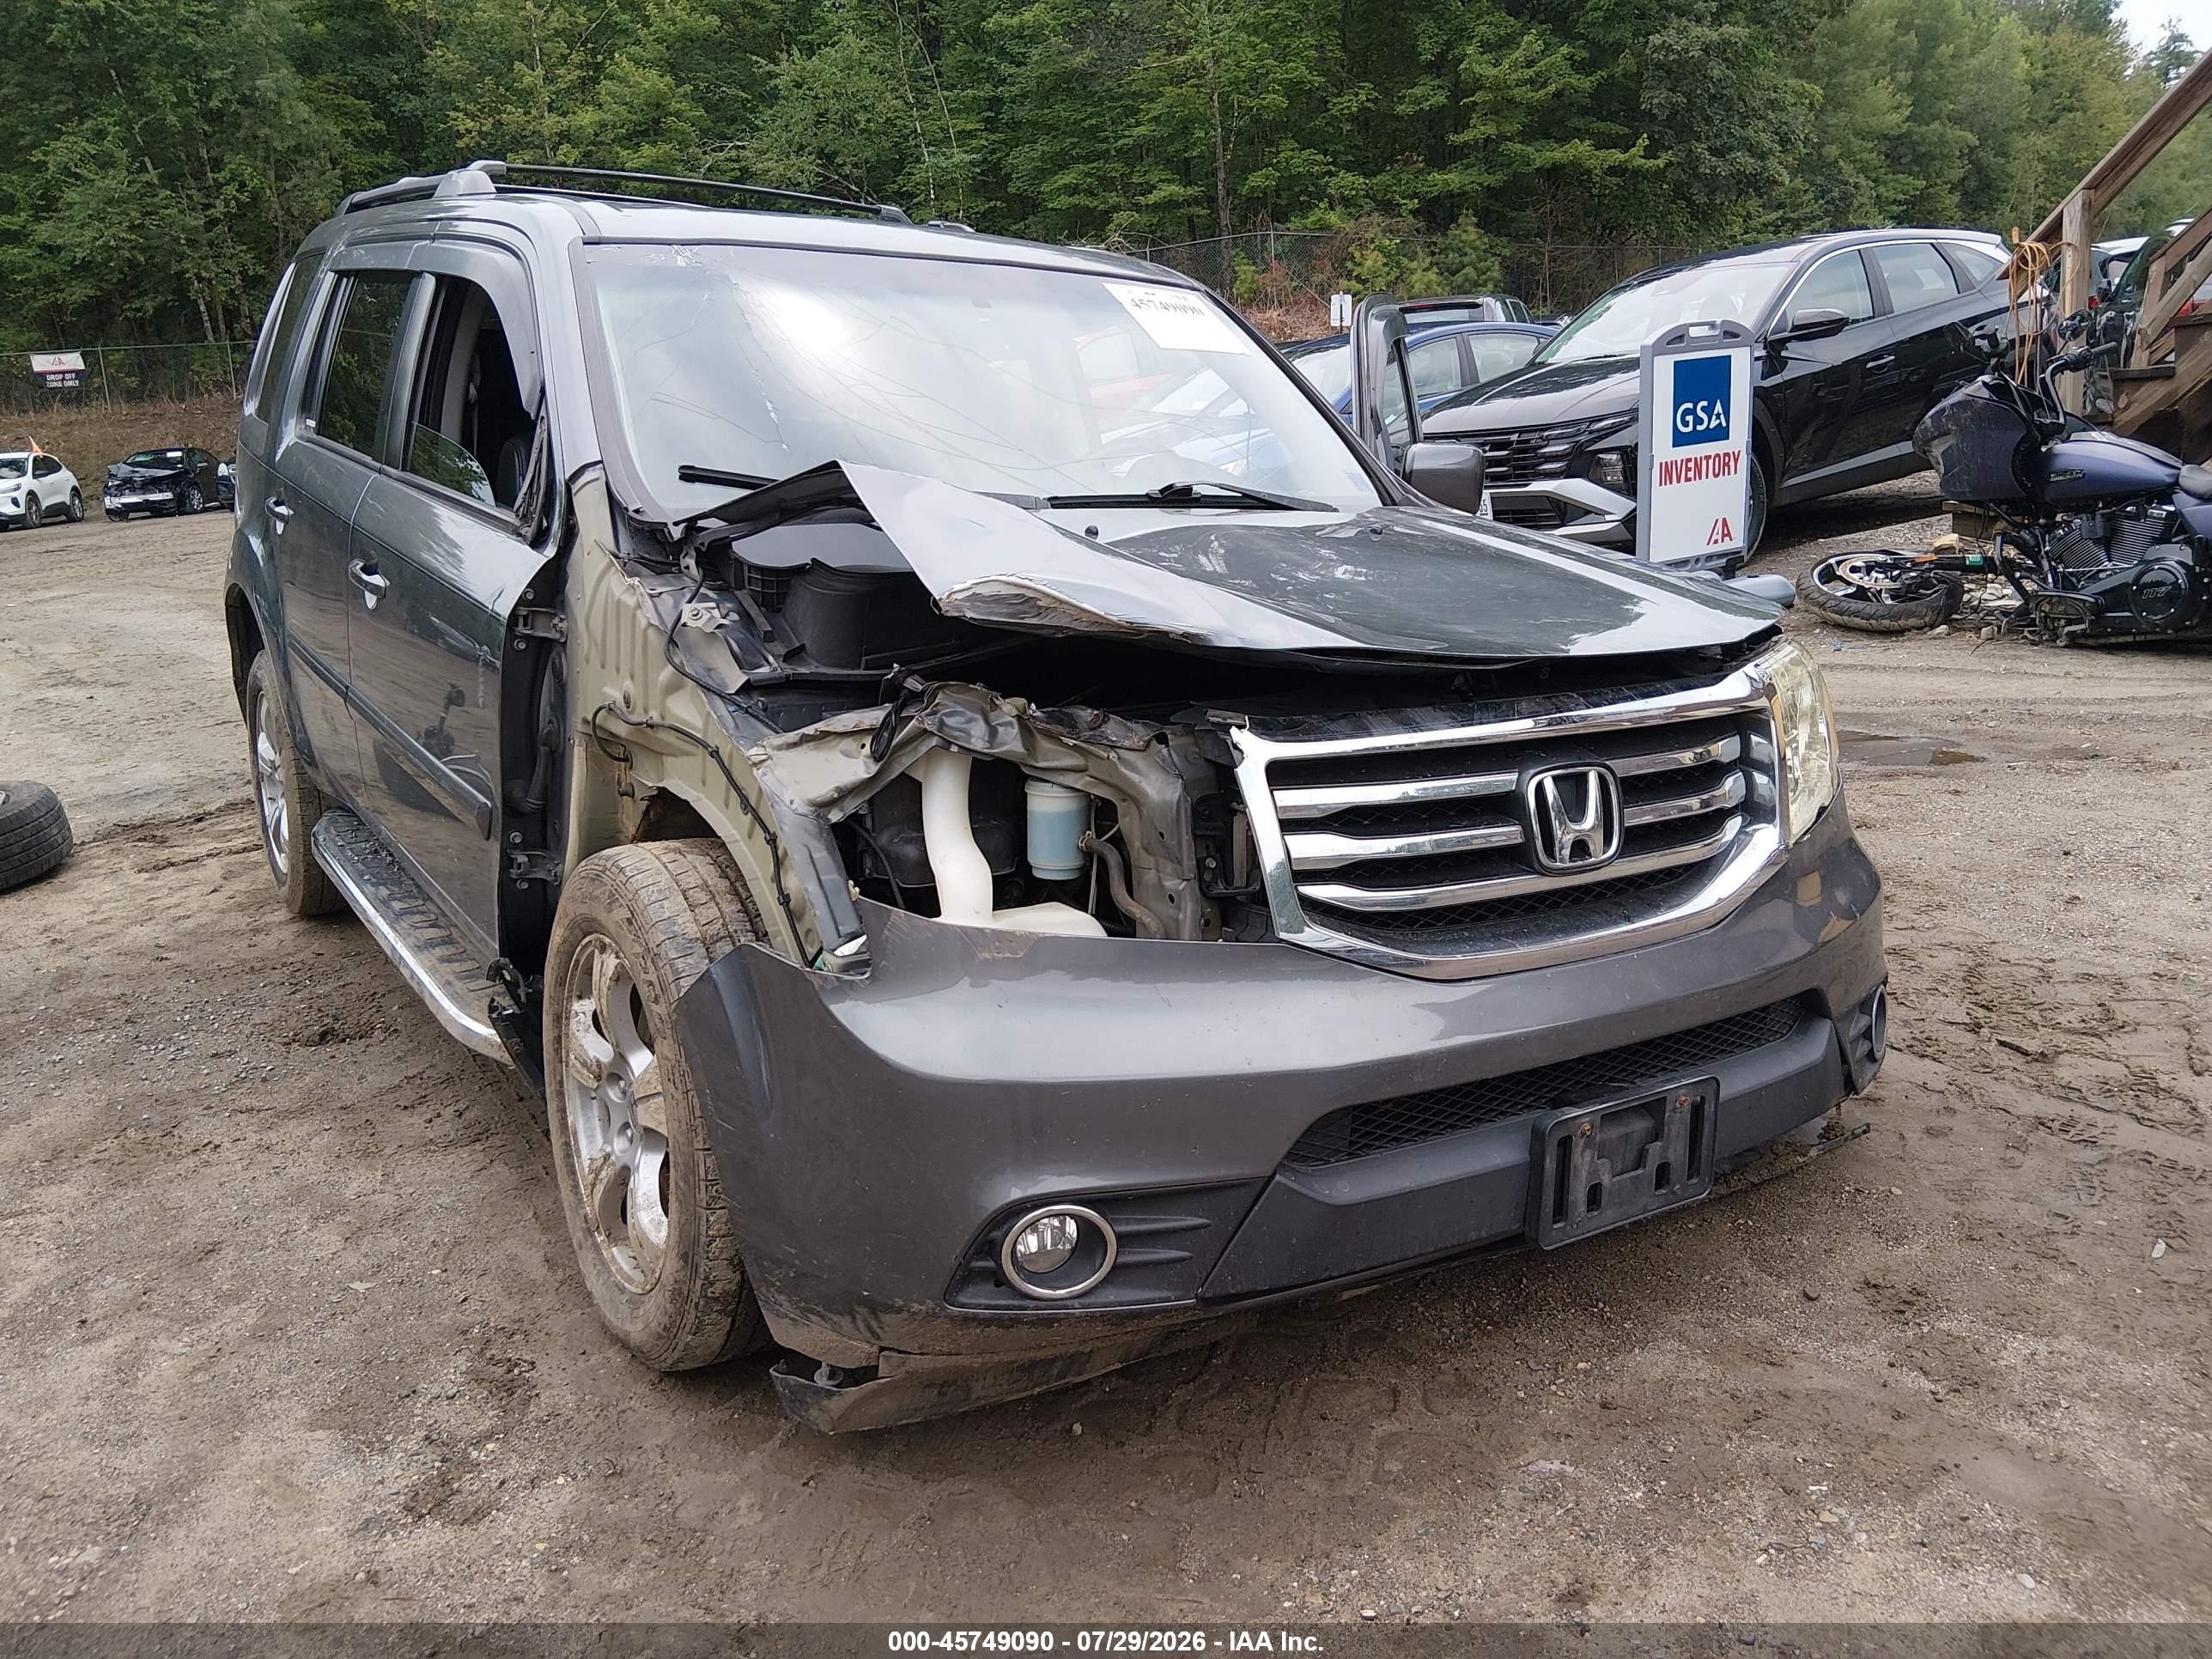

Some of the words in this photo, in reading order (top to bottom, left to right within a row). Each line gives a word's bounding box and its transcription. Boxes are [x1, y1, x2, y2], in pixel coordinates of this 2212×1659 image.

[1676, 398, 1727, 433] GSA
[1658, 449, 1741, 487] INVENTORY
[2142, 586, 2172, 599] 117
